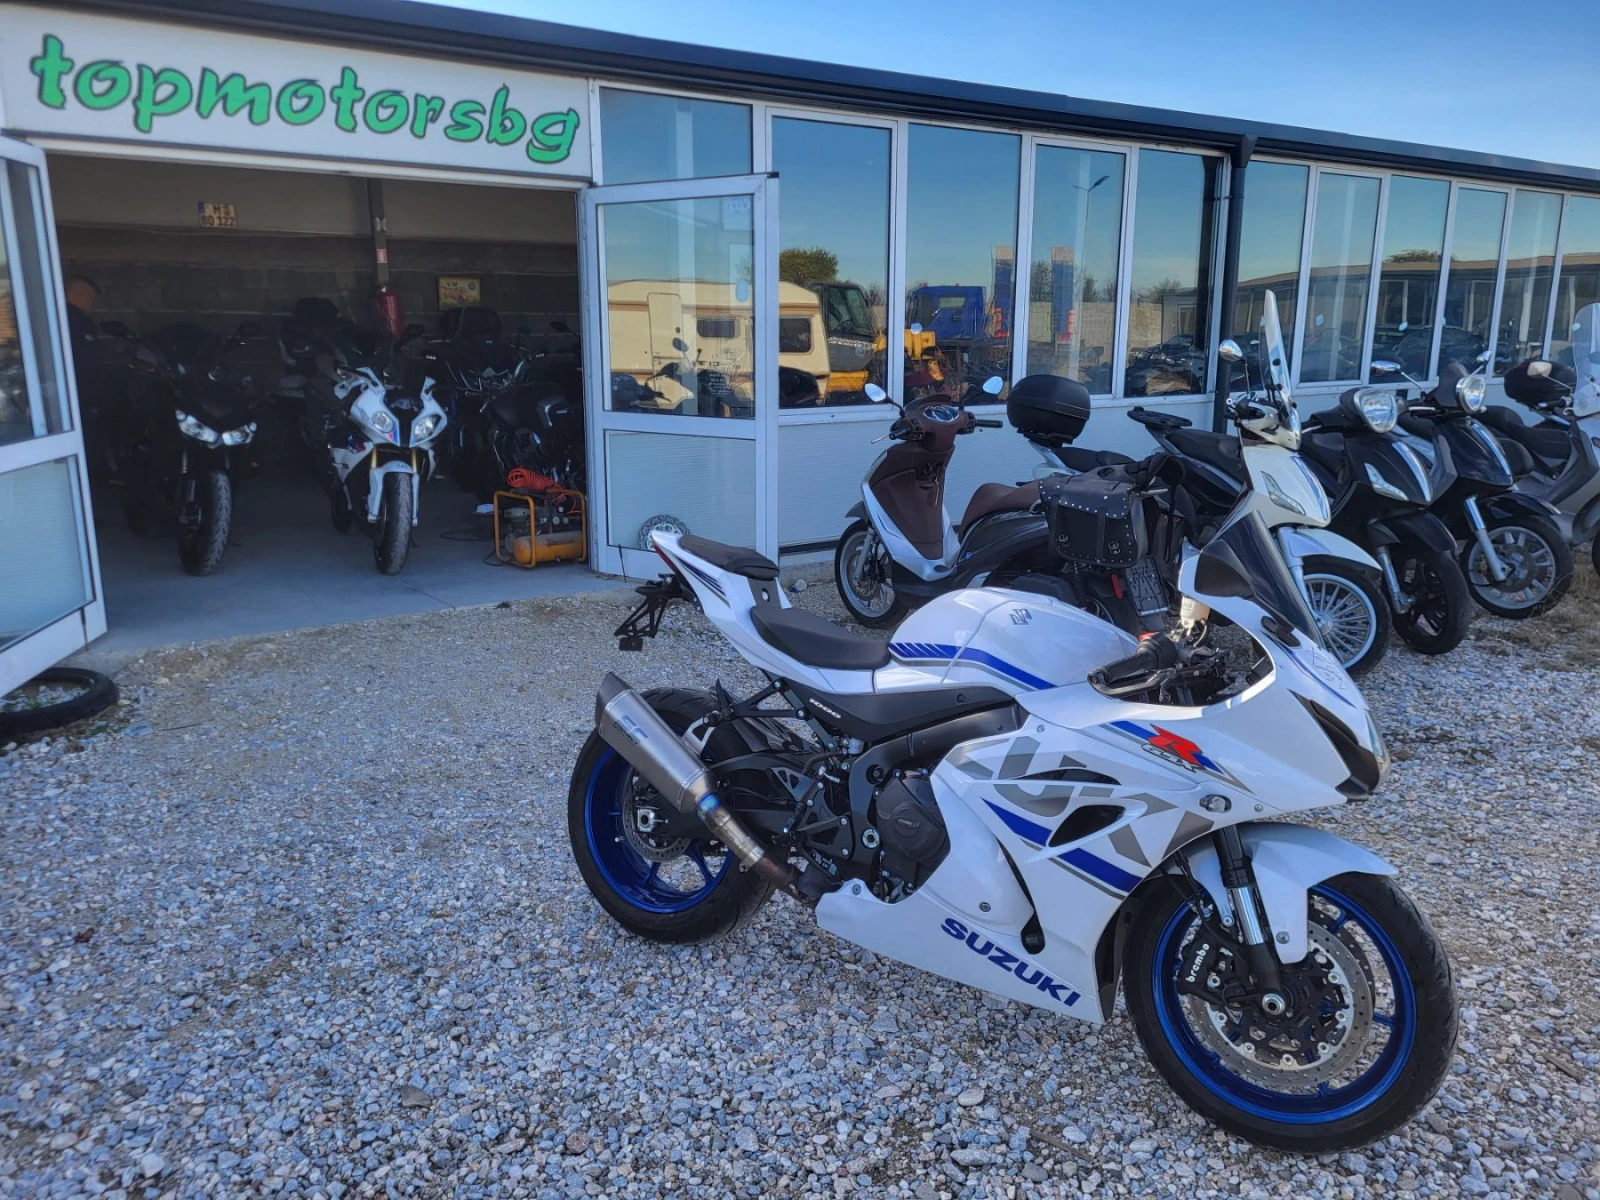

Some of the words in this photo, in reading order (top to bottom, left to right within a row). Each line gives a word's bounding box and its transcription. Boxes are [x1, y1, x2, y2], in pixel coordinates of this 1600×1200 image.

[30, 33, 580, 164] topmotorsbg
[940, 917, 1081, 1007] SUZUKI
[1185, 943, 1210, 983] brembo
